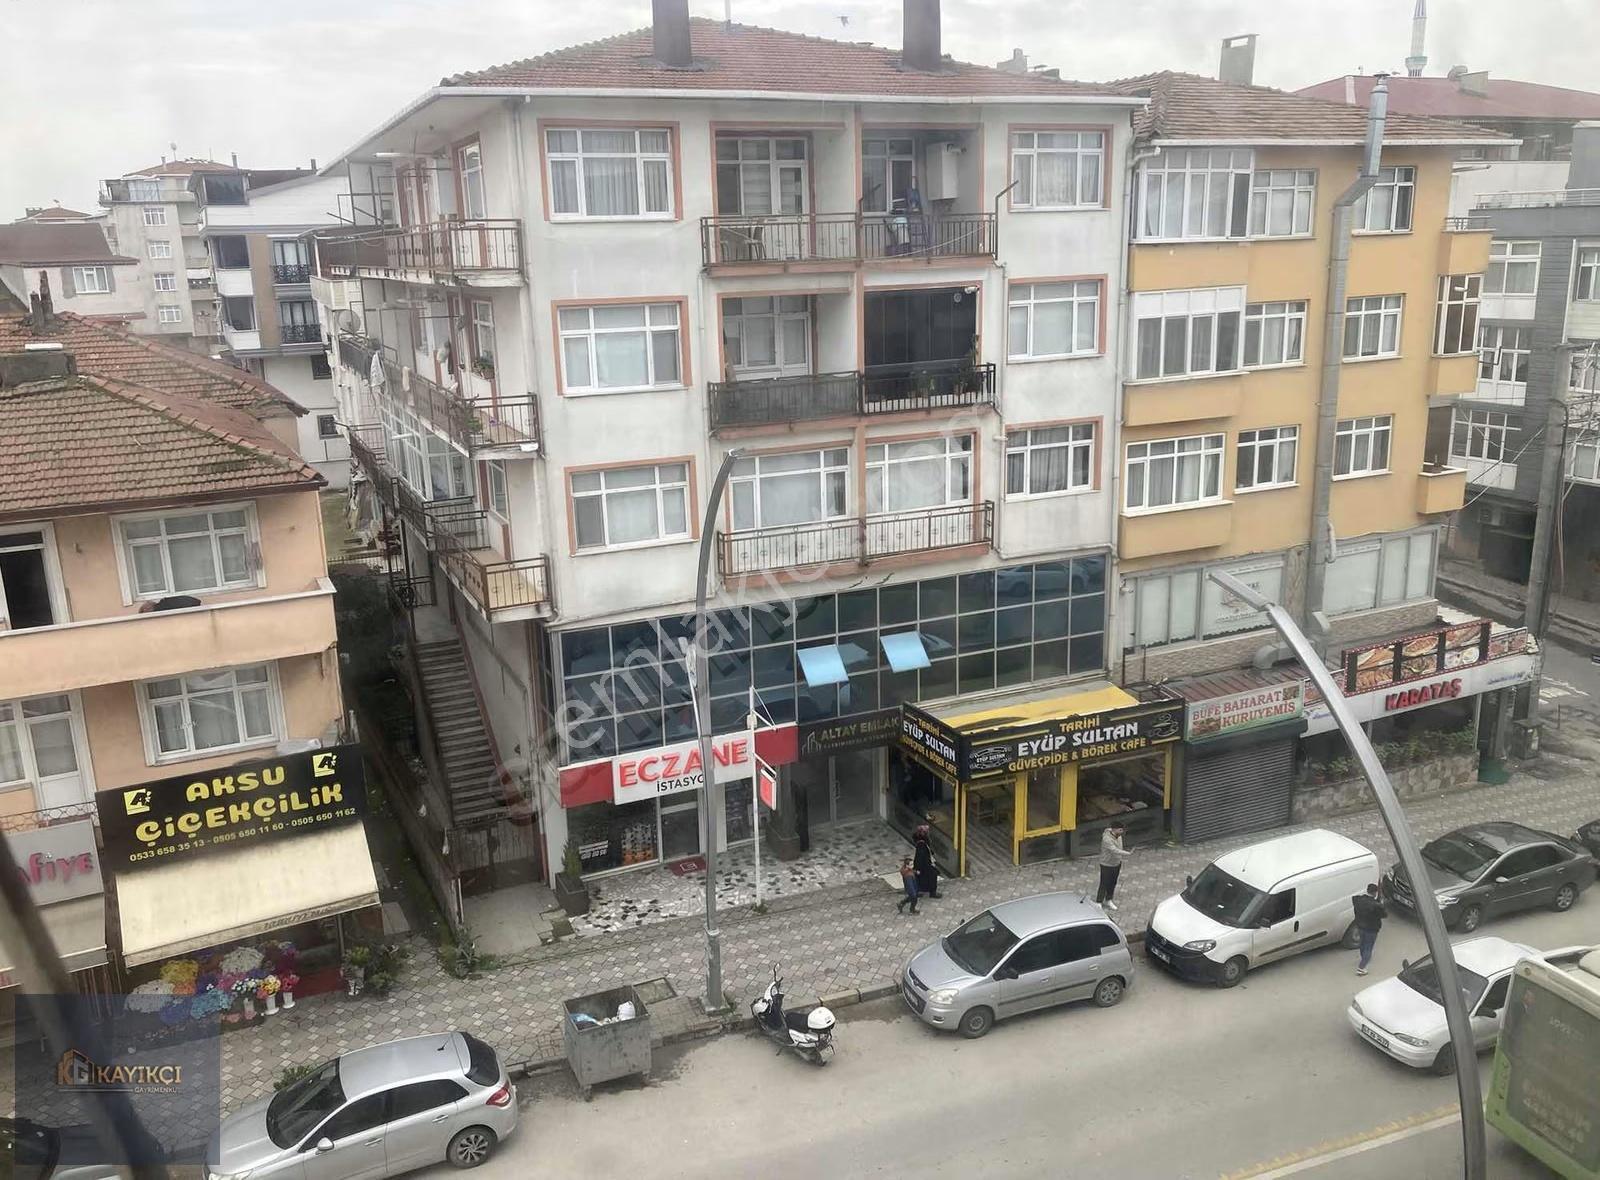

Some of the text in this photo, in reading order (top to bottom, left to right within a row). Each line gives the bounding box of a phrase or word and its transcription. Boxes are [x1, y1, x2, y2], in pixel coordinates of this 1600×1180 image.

[1192, 690, 1282, 722] BÜFE BAHARAT
[1384, 678, 1463, 712] KARATAŞ
[1059, 715, 1101, 733] TARİHİ
[1222, 700, 1296, 728] KURUYEMİŞ
[821, 724, 857, 741] ALTAY
[903, 720, 924, 740] EYÜP
[925, 733, 956, 762] SULTAN
[1017, 720, 1140, 757] EYÜP SULTAN
[1081, 742, 1118, 760] BÖREK
[1120, 737, 1147, 753] CAFE
[618, 738, 749, 789] ECZANE
[185, 766, 286, 803] AKSU
[135, 783, 344, 847] ÇİÇEKÇİLİK
[129, 847, 157, 862] 0533
[156, 844, 176, 857] 658
[178, 841, 191, 852] 35
[192, 838, 205, 849] 13
[213, 831, 237, 845] 0505
[238, 828, 257, 839] 650
[259, 825, 270, 835] 11
[291, 816, 314, 828] 0505
[316, 810, 334, 822] 650
